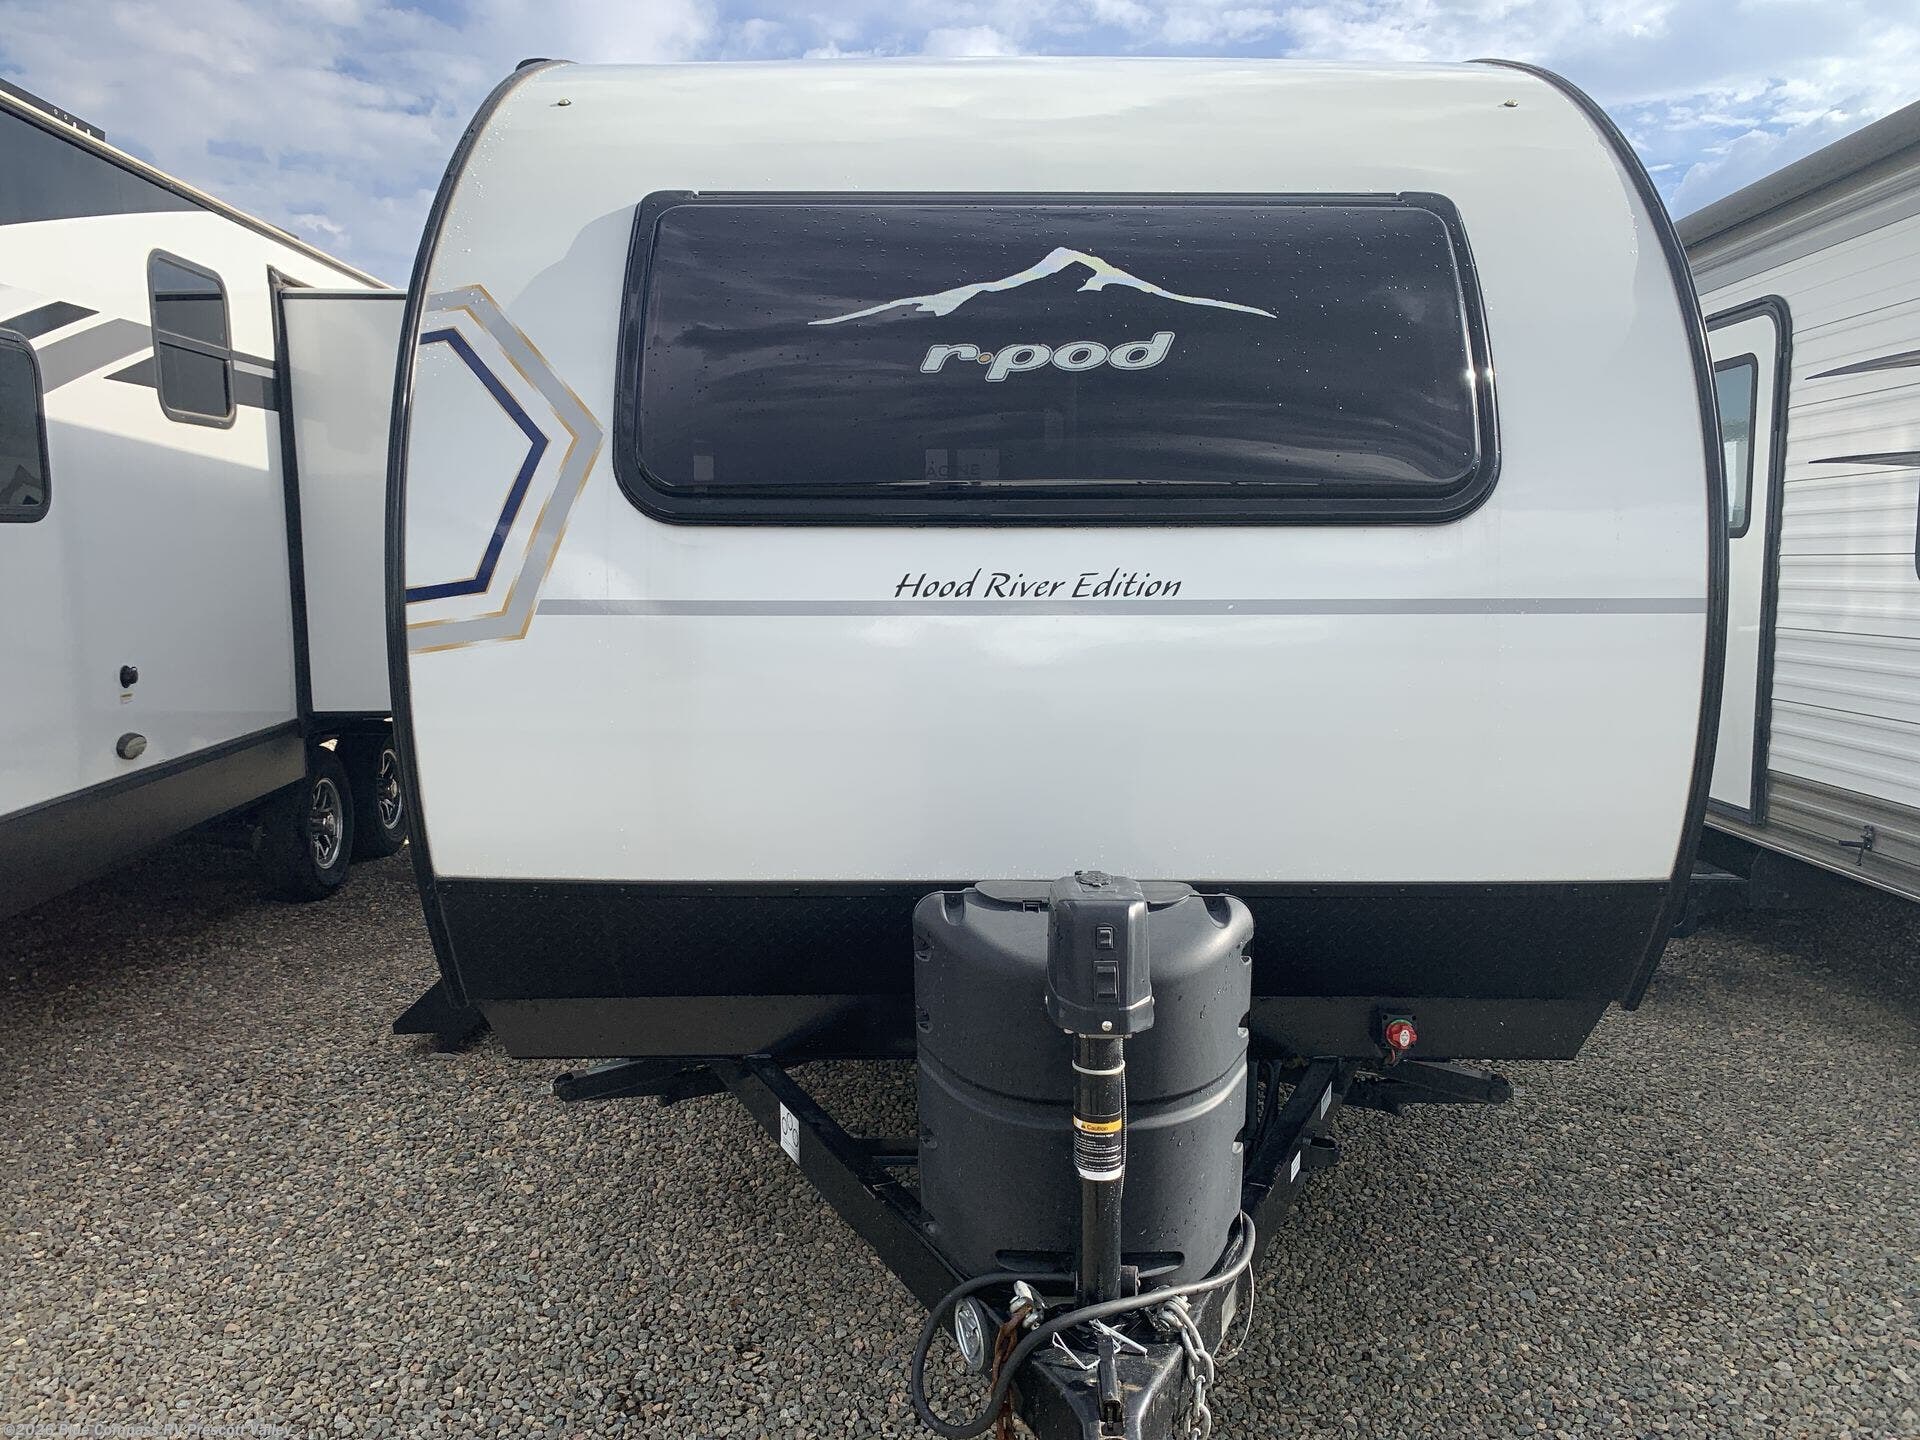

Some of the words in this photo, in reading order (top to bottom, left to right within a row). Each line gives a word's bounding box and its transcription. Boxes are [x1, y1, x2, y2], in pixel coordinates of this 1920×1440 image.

[894, 567, 981, 598] Hood
[983, 572, 1066, 598] River
[1071, 567, 1182, 598] Edition
